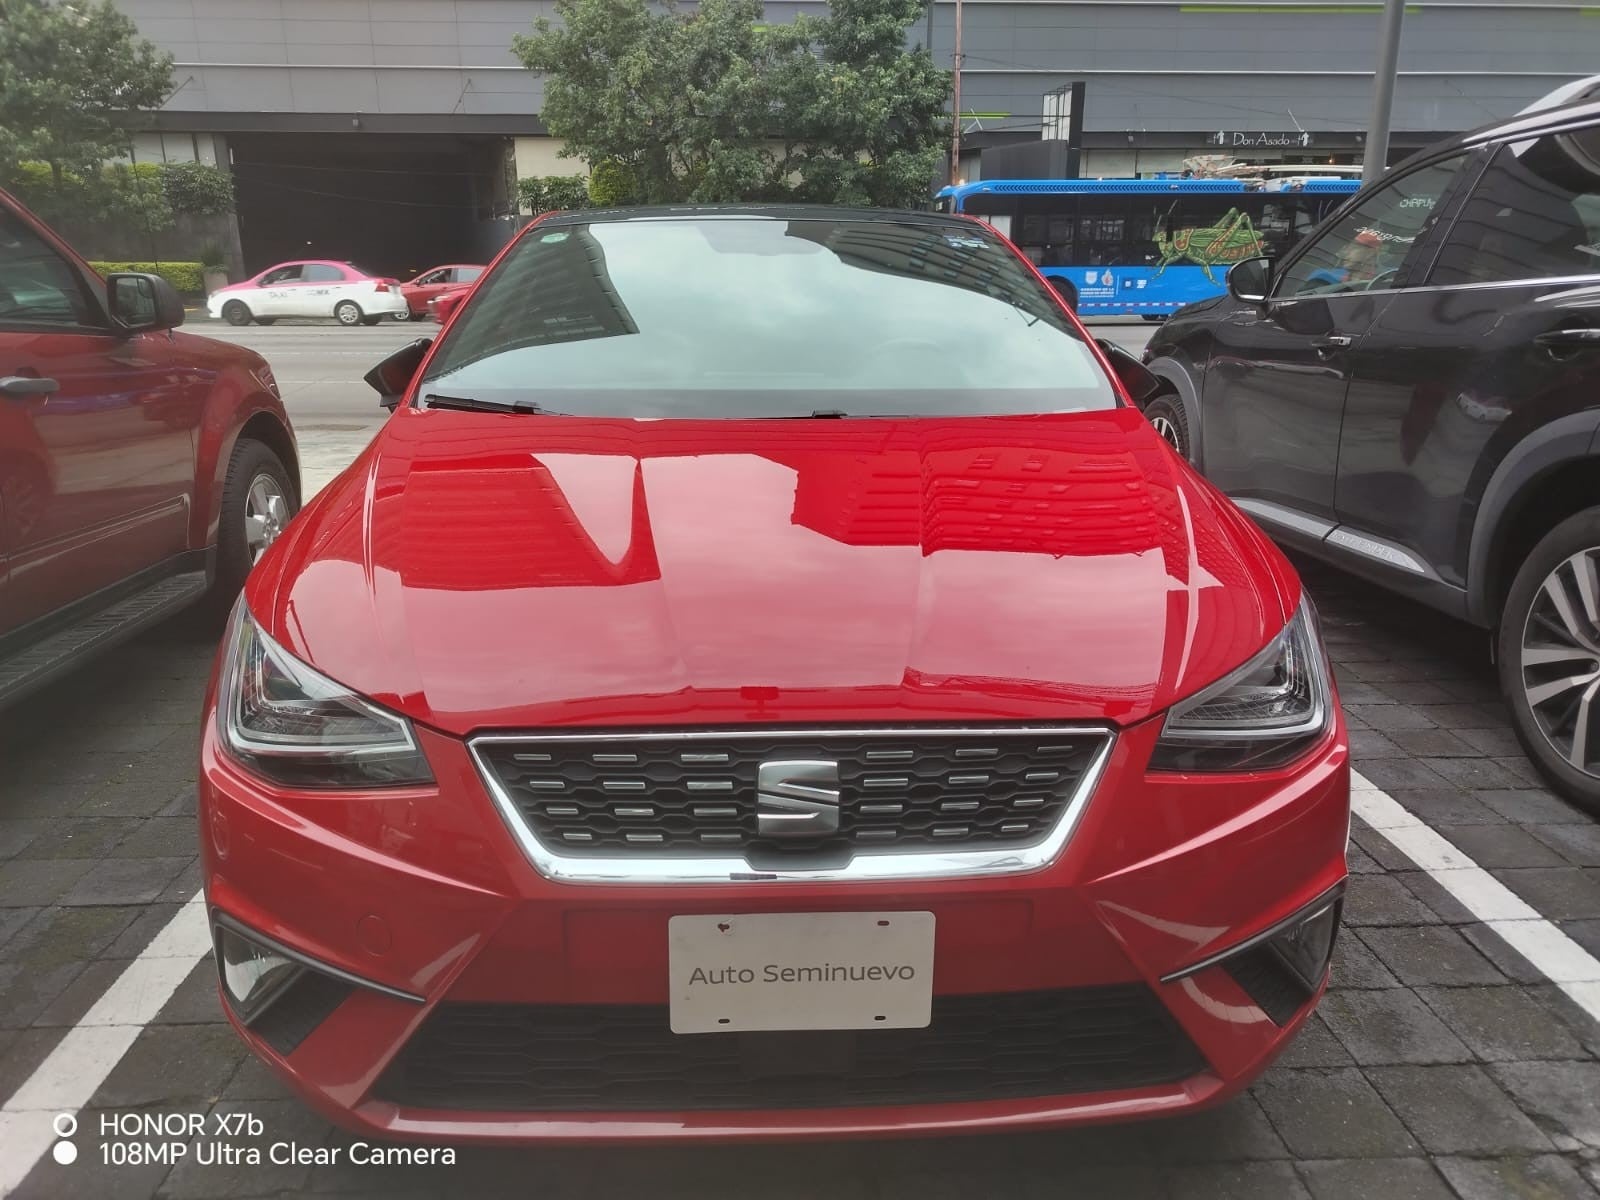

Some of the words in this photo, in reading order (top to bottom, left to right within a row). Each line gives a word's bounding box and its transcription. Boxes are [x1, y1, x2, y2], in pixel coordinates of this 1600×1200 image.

[1232, 132, 1254, 146] Don
[1255, 132, 1290, 146] Asado
[689, 965, 754, 986] Auto
[762, 963, 915, 984] Seminuevo
